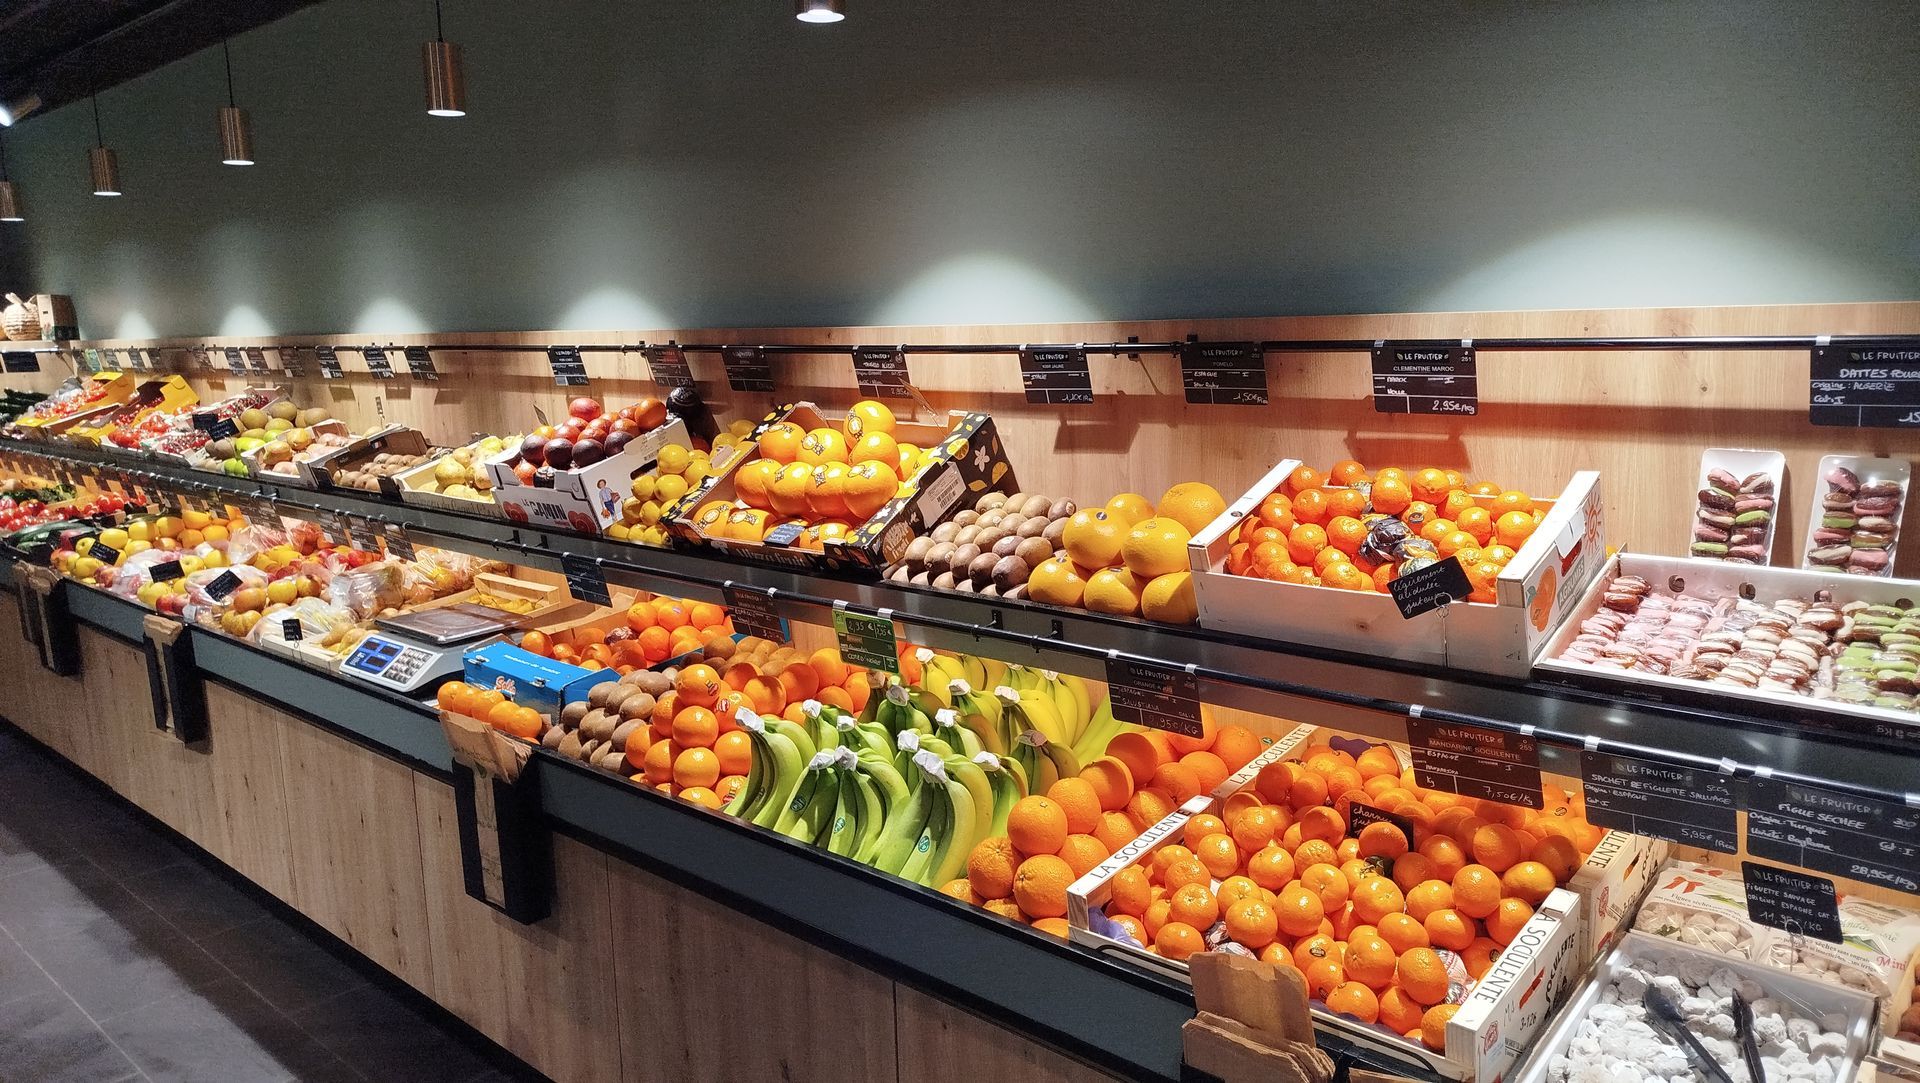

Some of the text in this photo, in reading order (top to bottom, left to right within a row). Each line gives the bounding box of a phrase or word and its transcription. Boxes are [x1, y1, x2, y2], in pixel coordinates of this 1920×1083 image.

[1414, 352, 1443, 361] FRUITIER
[1862, 351, 1920, 360] LE FRUITIER
[1839, 368, 1889, 379] DATTES
[530, 500, 568, 520] GAMIN
[1145, 670, 1171, 680] FRUITIER
[1447, 731, 1496, 744] LE FRUITIER
[1229, 727, 1313, 785] LA SOCULENTE
[1428, 739, 1521, 761] MANDARINE SOCULENTE
[1626, 764, 1684, 781] LE FRUITIER
[1590, 773, 1629, 787] SACHET
[1642, 782, 1688, 797] FIGUETTE
[1804, 795, 1872, 815] LE FRUITIER
[1777, 802, 1869, 831] FIGUE SECHEE
[1090, 808, 1193, 879] LA SOCULENTE
[1762, 871, 1812, 889] LE FRUITIER
[1745, 883, 1780, 897] FIGUETTE
[1781, 901, 1814, 916] ESPAGNE
[1817, 911, 1830, 920] CAT
[1473, 906, 1564, 1004] LA SOCULENTE
